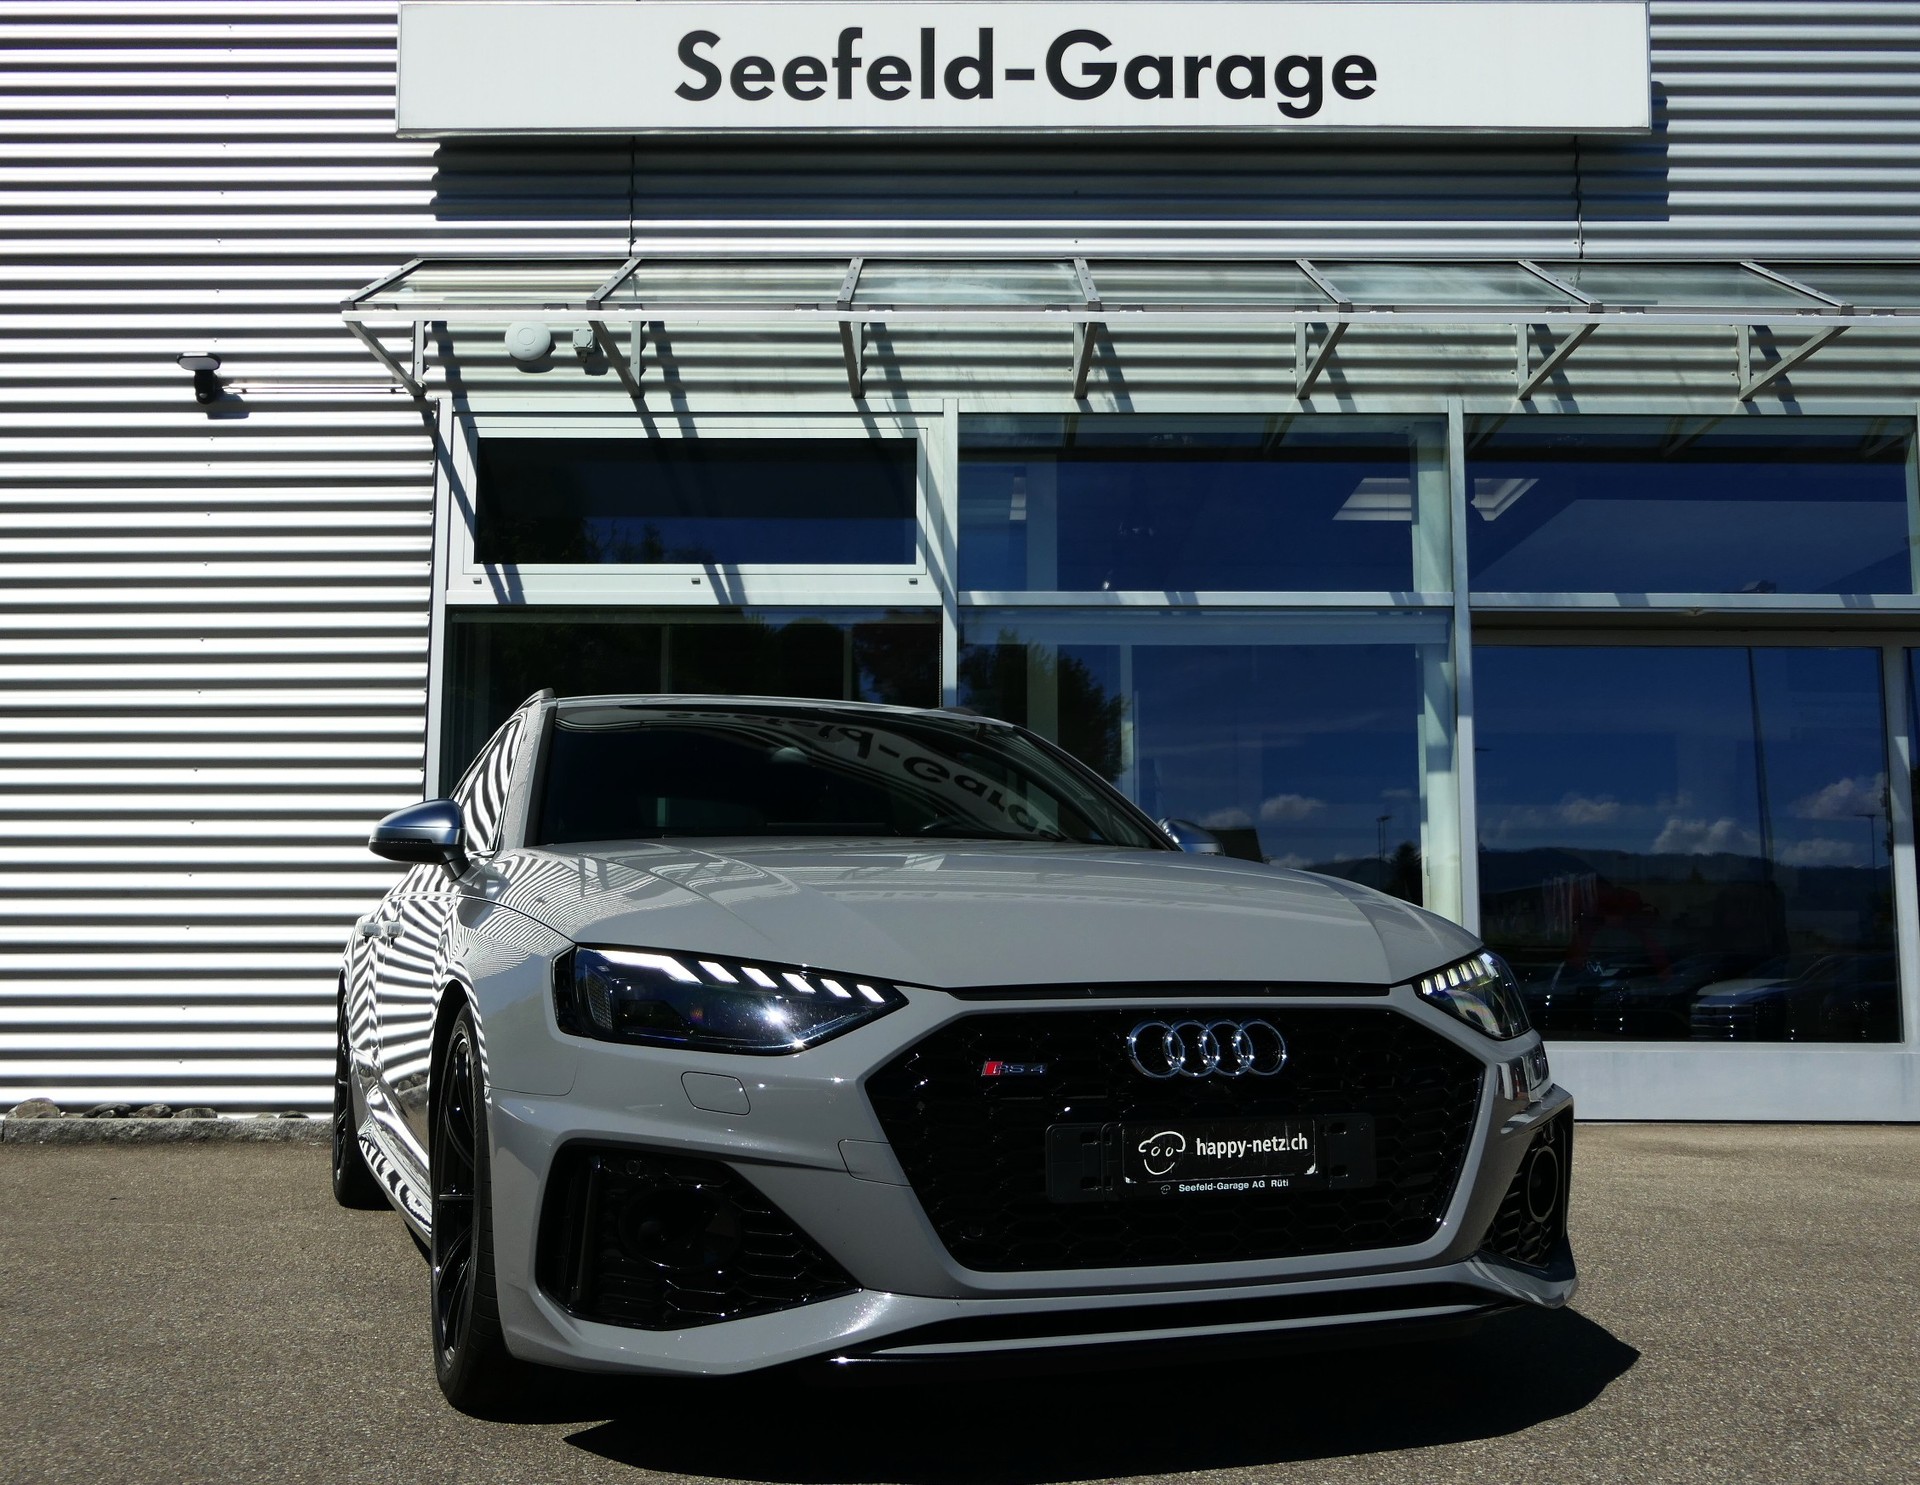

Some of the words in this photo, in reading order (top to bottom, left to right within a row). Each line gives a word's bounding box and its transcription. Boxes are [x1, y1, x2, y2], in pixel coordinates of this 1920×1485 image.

[674, 27, 1378, 119] Seefeld-Garage
[1196, 1132, 1308, 1159] happy-netz.ch
[1178, 1181, 1250, 1192] Seefeld-Garage
[1252, 1180, 1266, 1188] AG
[1270, 1179, 1289, 1188] Rüti
